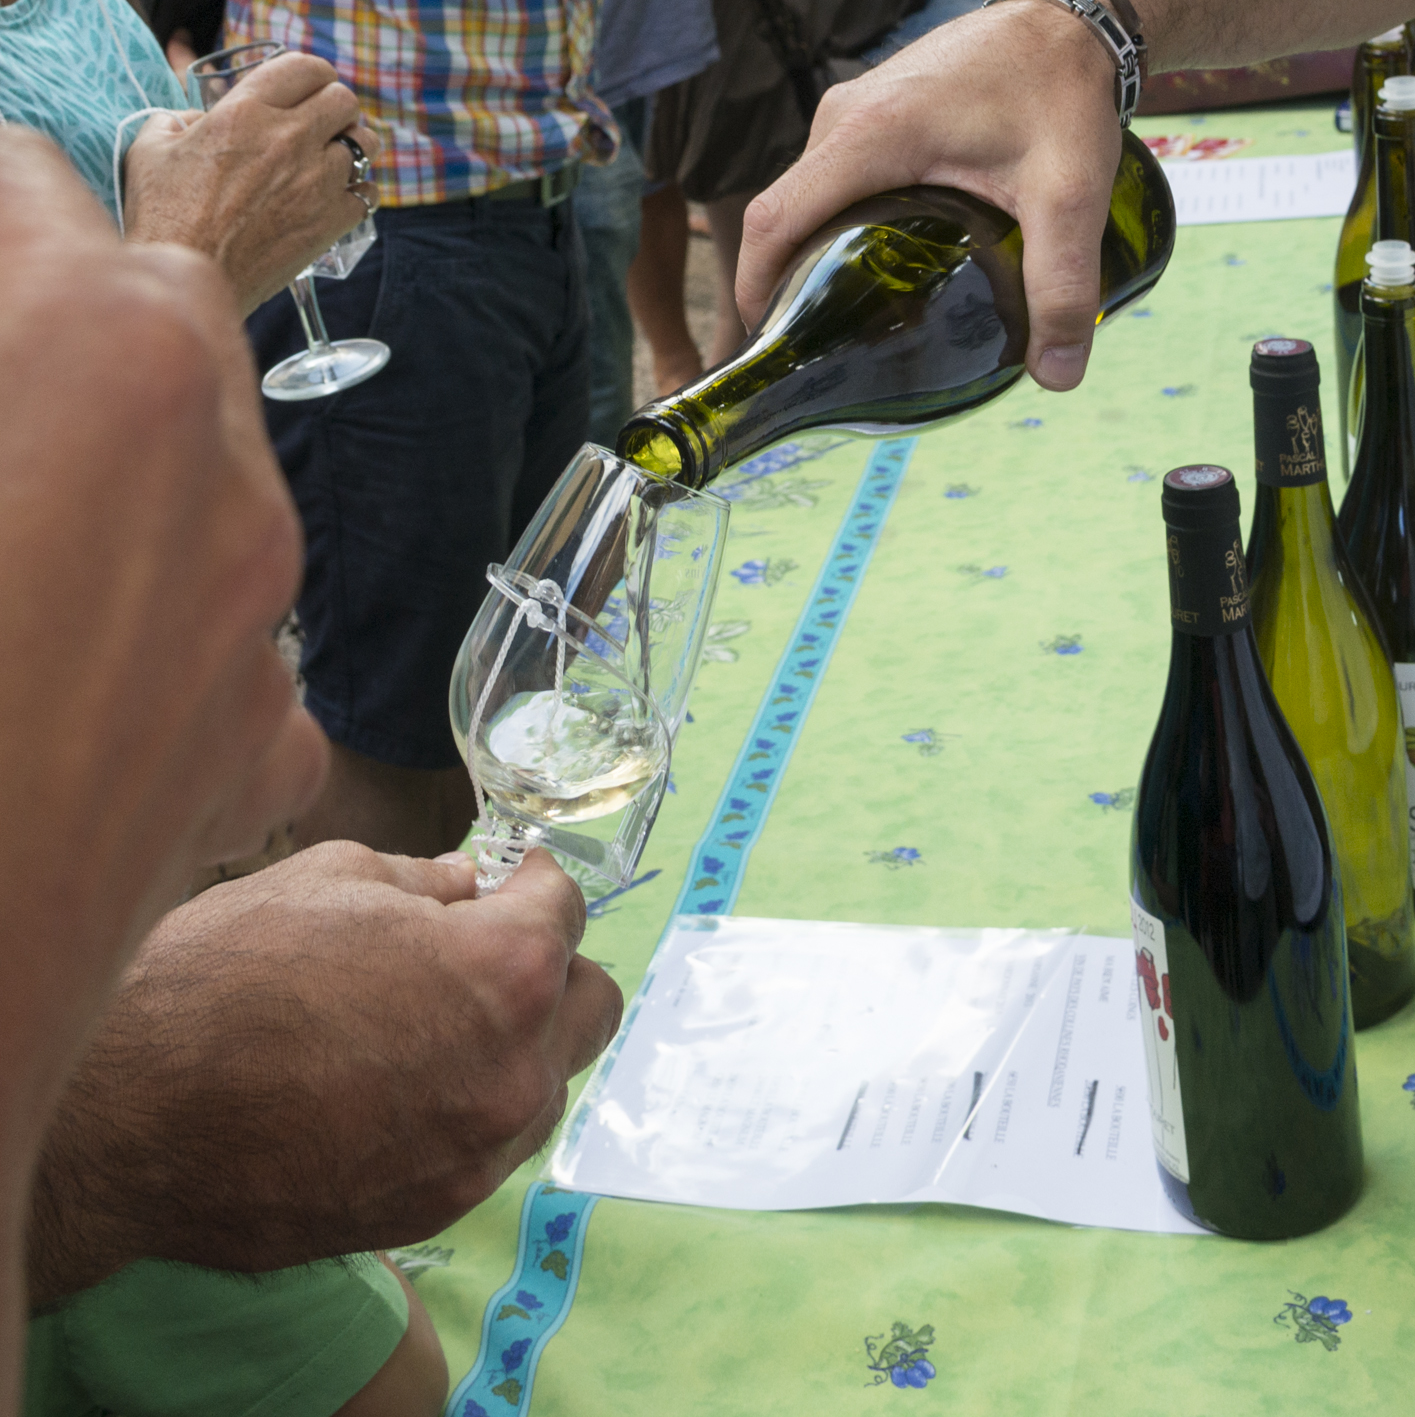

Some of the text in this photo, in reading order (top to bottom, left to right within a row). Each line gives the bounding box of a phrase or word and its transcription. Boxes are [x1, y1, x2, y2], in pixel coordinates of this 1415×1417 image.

[1279, 451, 1316, 463] PASCAL
[994, 1098, 1012, 1144] BOUTEILLE
[1106, 1114, 1120, 1160] BOUTEILLE
